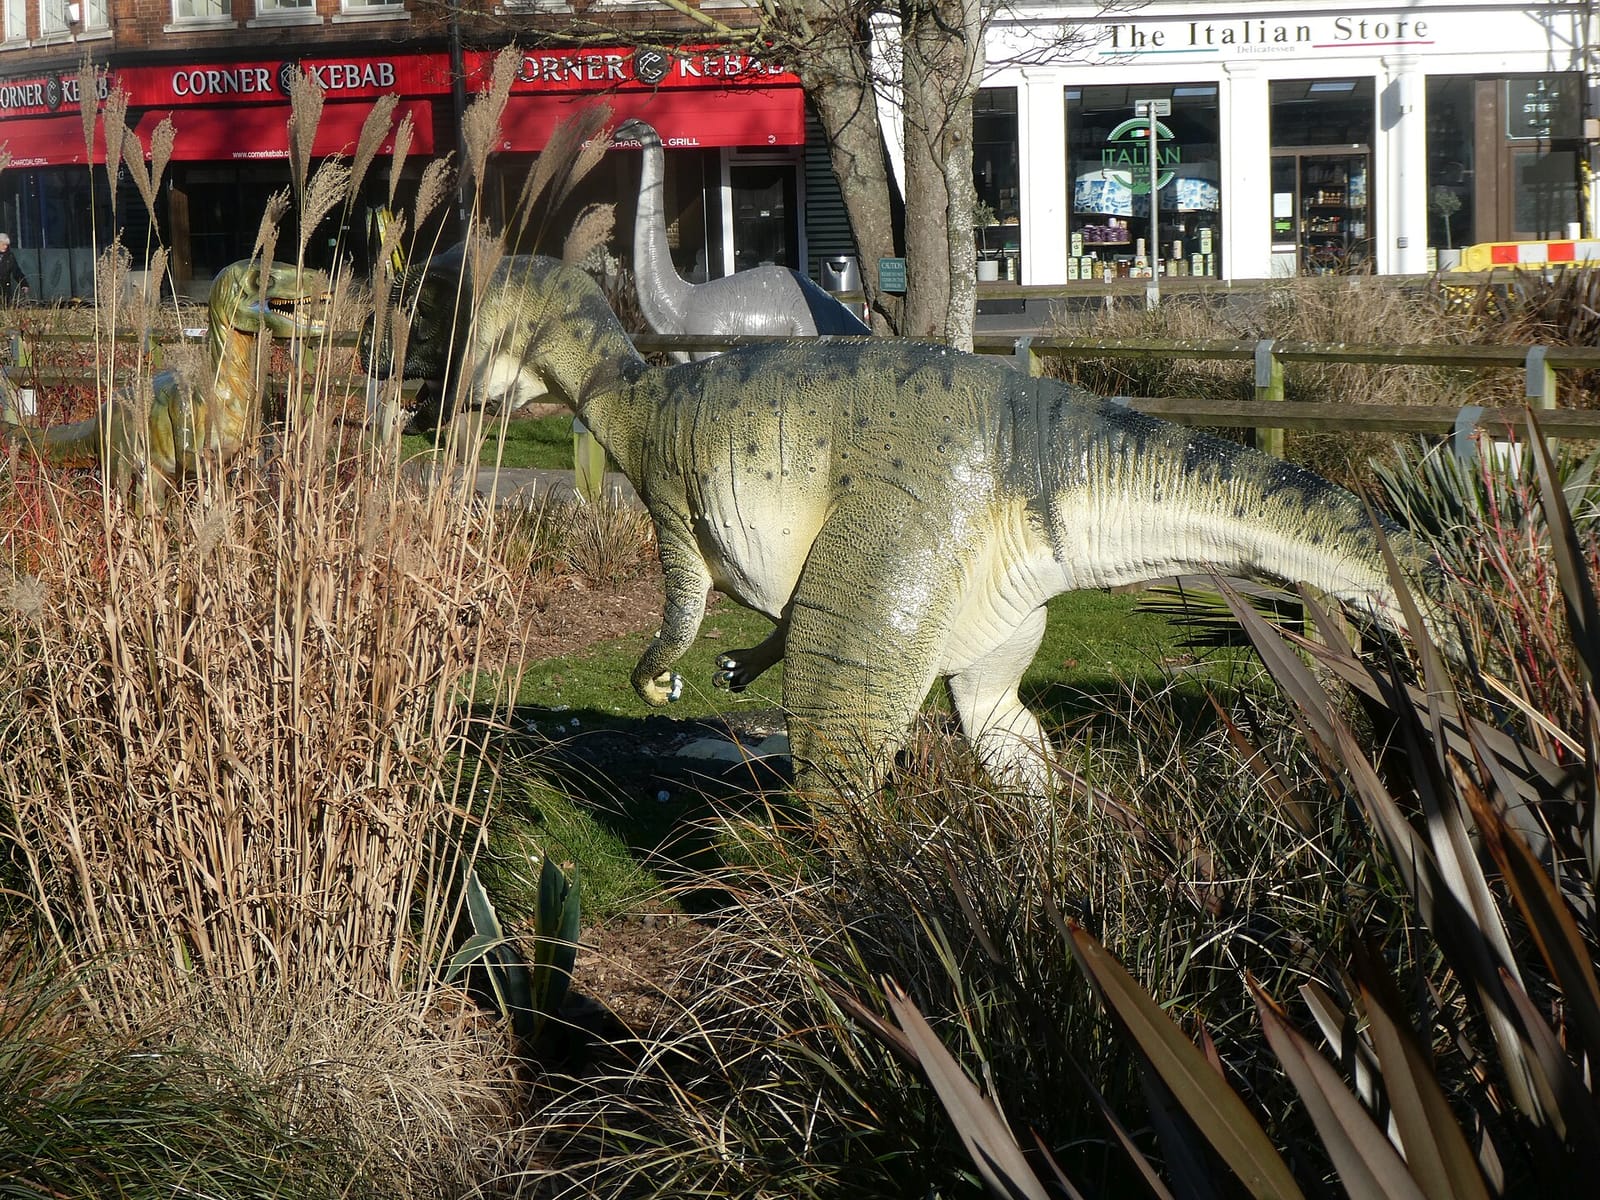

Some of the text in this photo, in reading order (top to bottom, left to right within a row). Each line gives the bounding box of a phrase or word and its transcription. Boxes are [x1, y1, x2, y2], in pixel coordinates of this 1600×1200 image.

[1105, 16, 1428, 48] The Italian Store
[1236, 45, 1295, 54] Delicatessen
[518, 54, 627, 83] ORNER
[172, 62, 395, 96] CORNER KEBAB
[0, 77, 108, 109] ORNER KEB
[609, 136, 700, 148] CHARL GRILL
[232, 149, 290, 159] www.cornerkebab.c
[1102, 148, 1180, 166] ITALIAN
[1127, 166, 1151, 174] STOR
